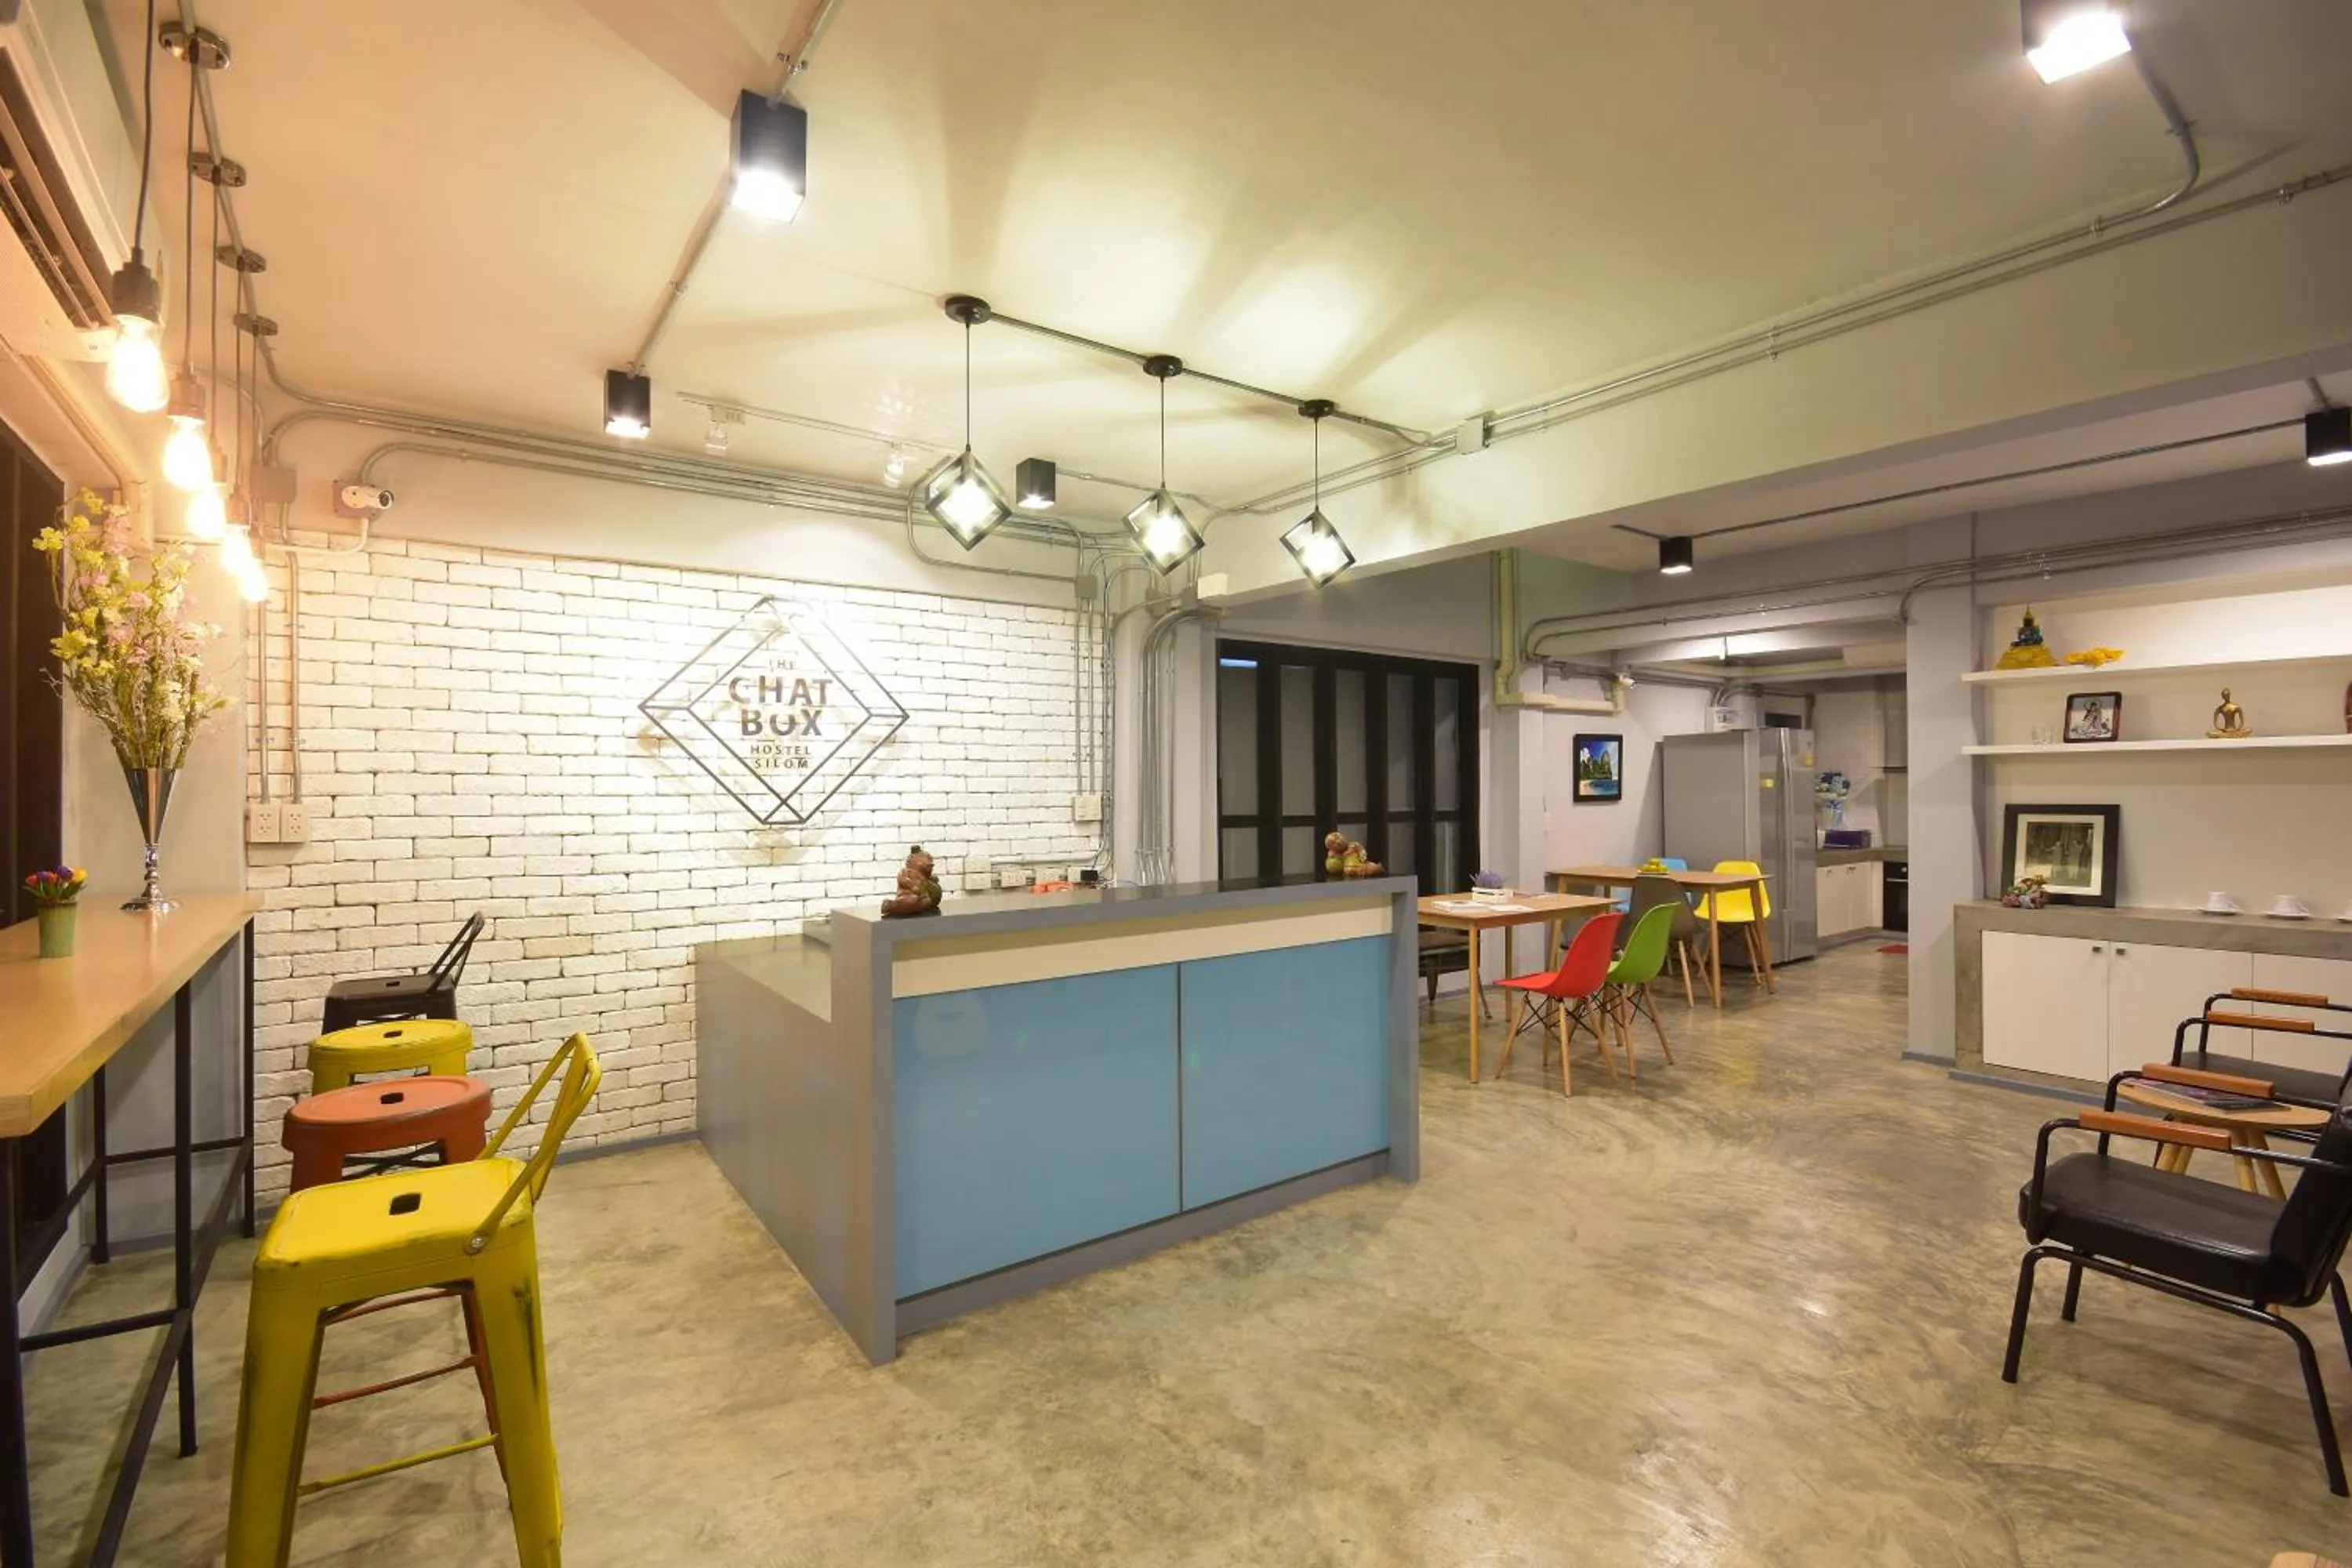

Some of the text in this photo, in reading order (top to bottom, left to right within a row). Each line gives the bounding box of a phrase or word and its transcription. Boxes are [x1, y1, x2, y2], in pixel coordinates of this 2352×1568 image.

[729, 675, 833, 705] CHAT
[741, 709, 822, 735] BOX
[751, 744, 811, 754] HOSTEL
[754, 757, 808, 768] SILOM
